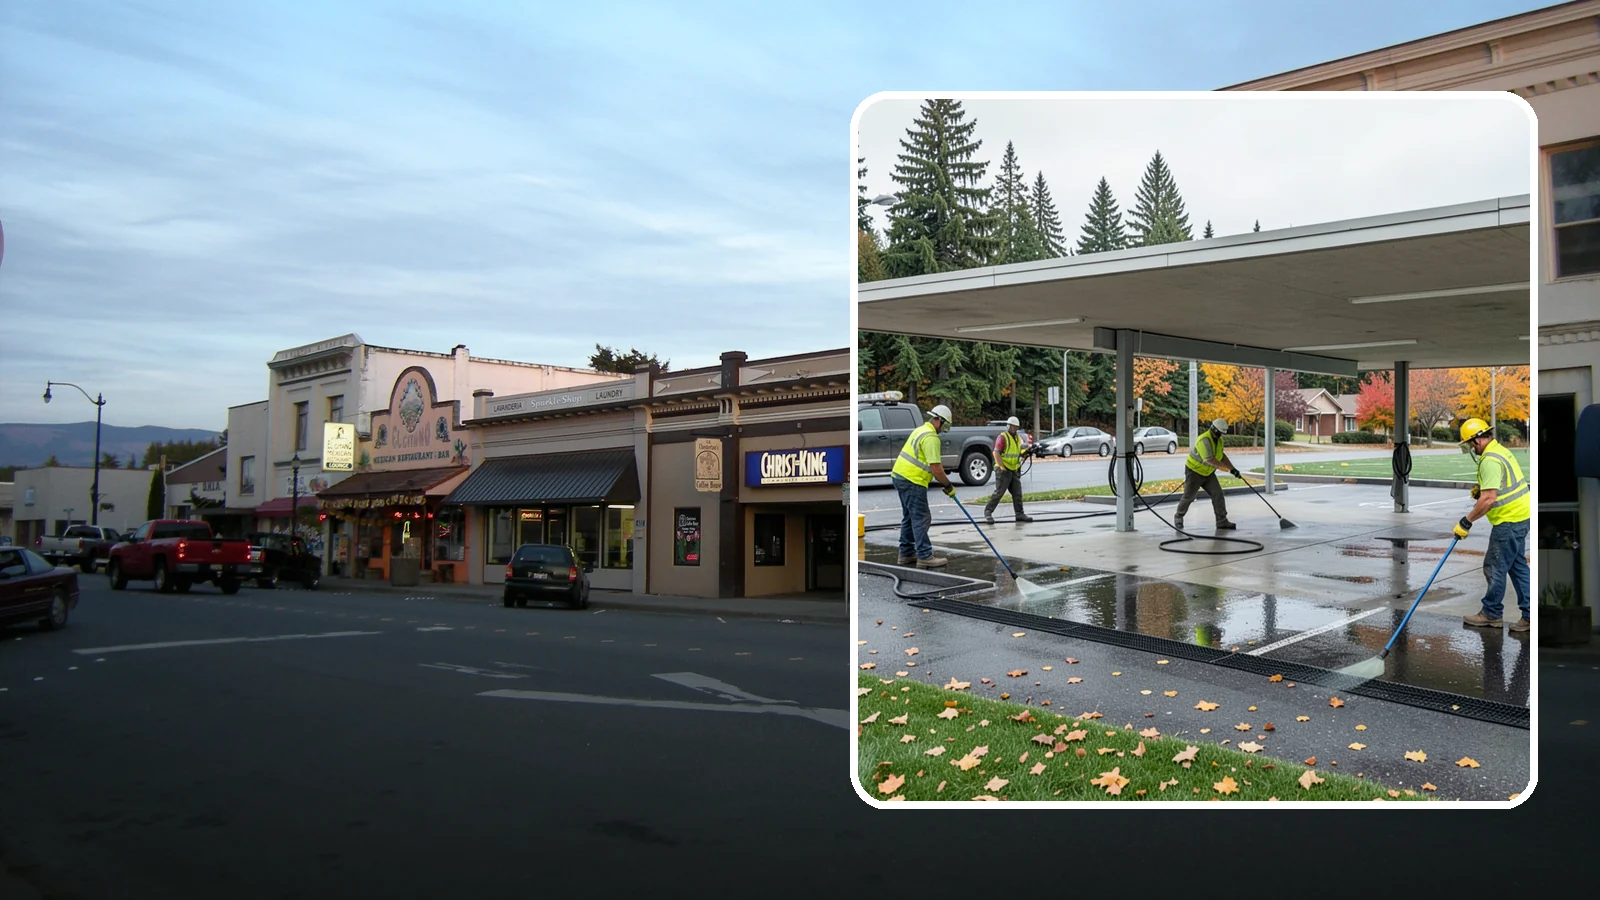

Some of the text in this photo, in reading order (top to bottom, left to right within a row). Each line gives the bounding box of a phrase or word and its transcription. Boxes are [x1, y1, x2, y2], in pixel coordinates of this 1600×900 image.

[596, 390, 623, 400] LAUNDRY
[494, 402, 522, 412] LAVANDERIA
[531, 395, 583, 409] Sparkle Shop
[374, 455, 396, 464] MEXICAN
[398, 452, 433, 462] RESTAURANT
[438, 451, 450, 459] BAR
[800, 450, 827, 476] KING
